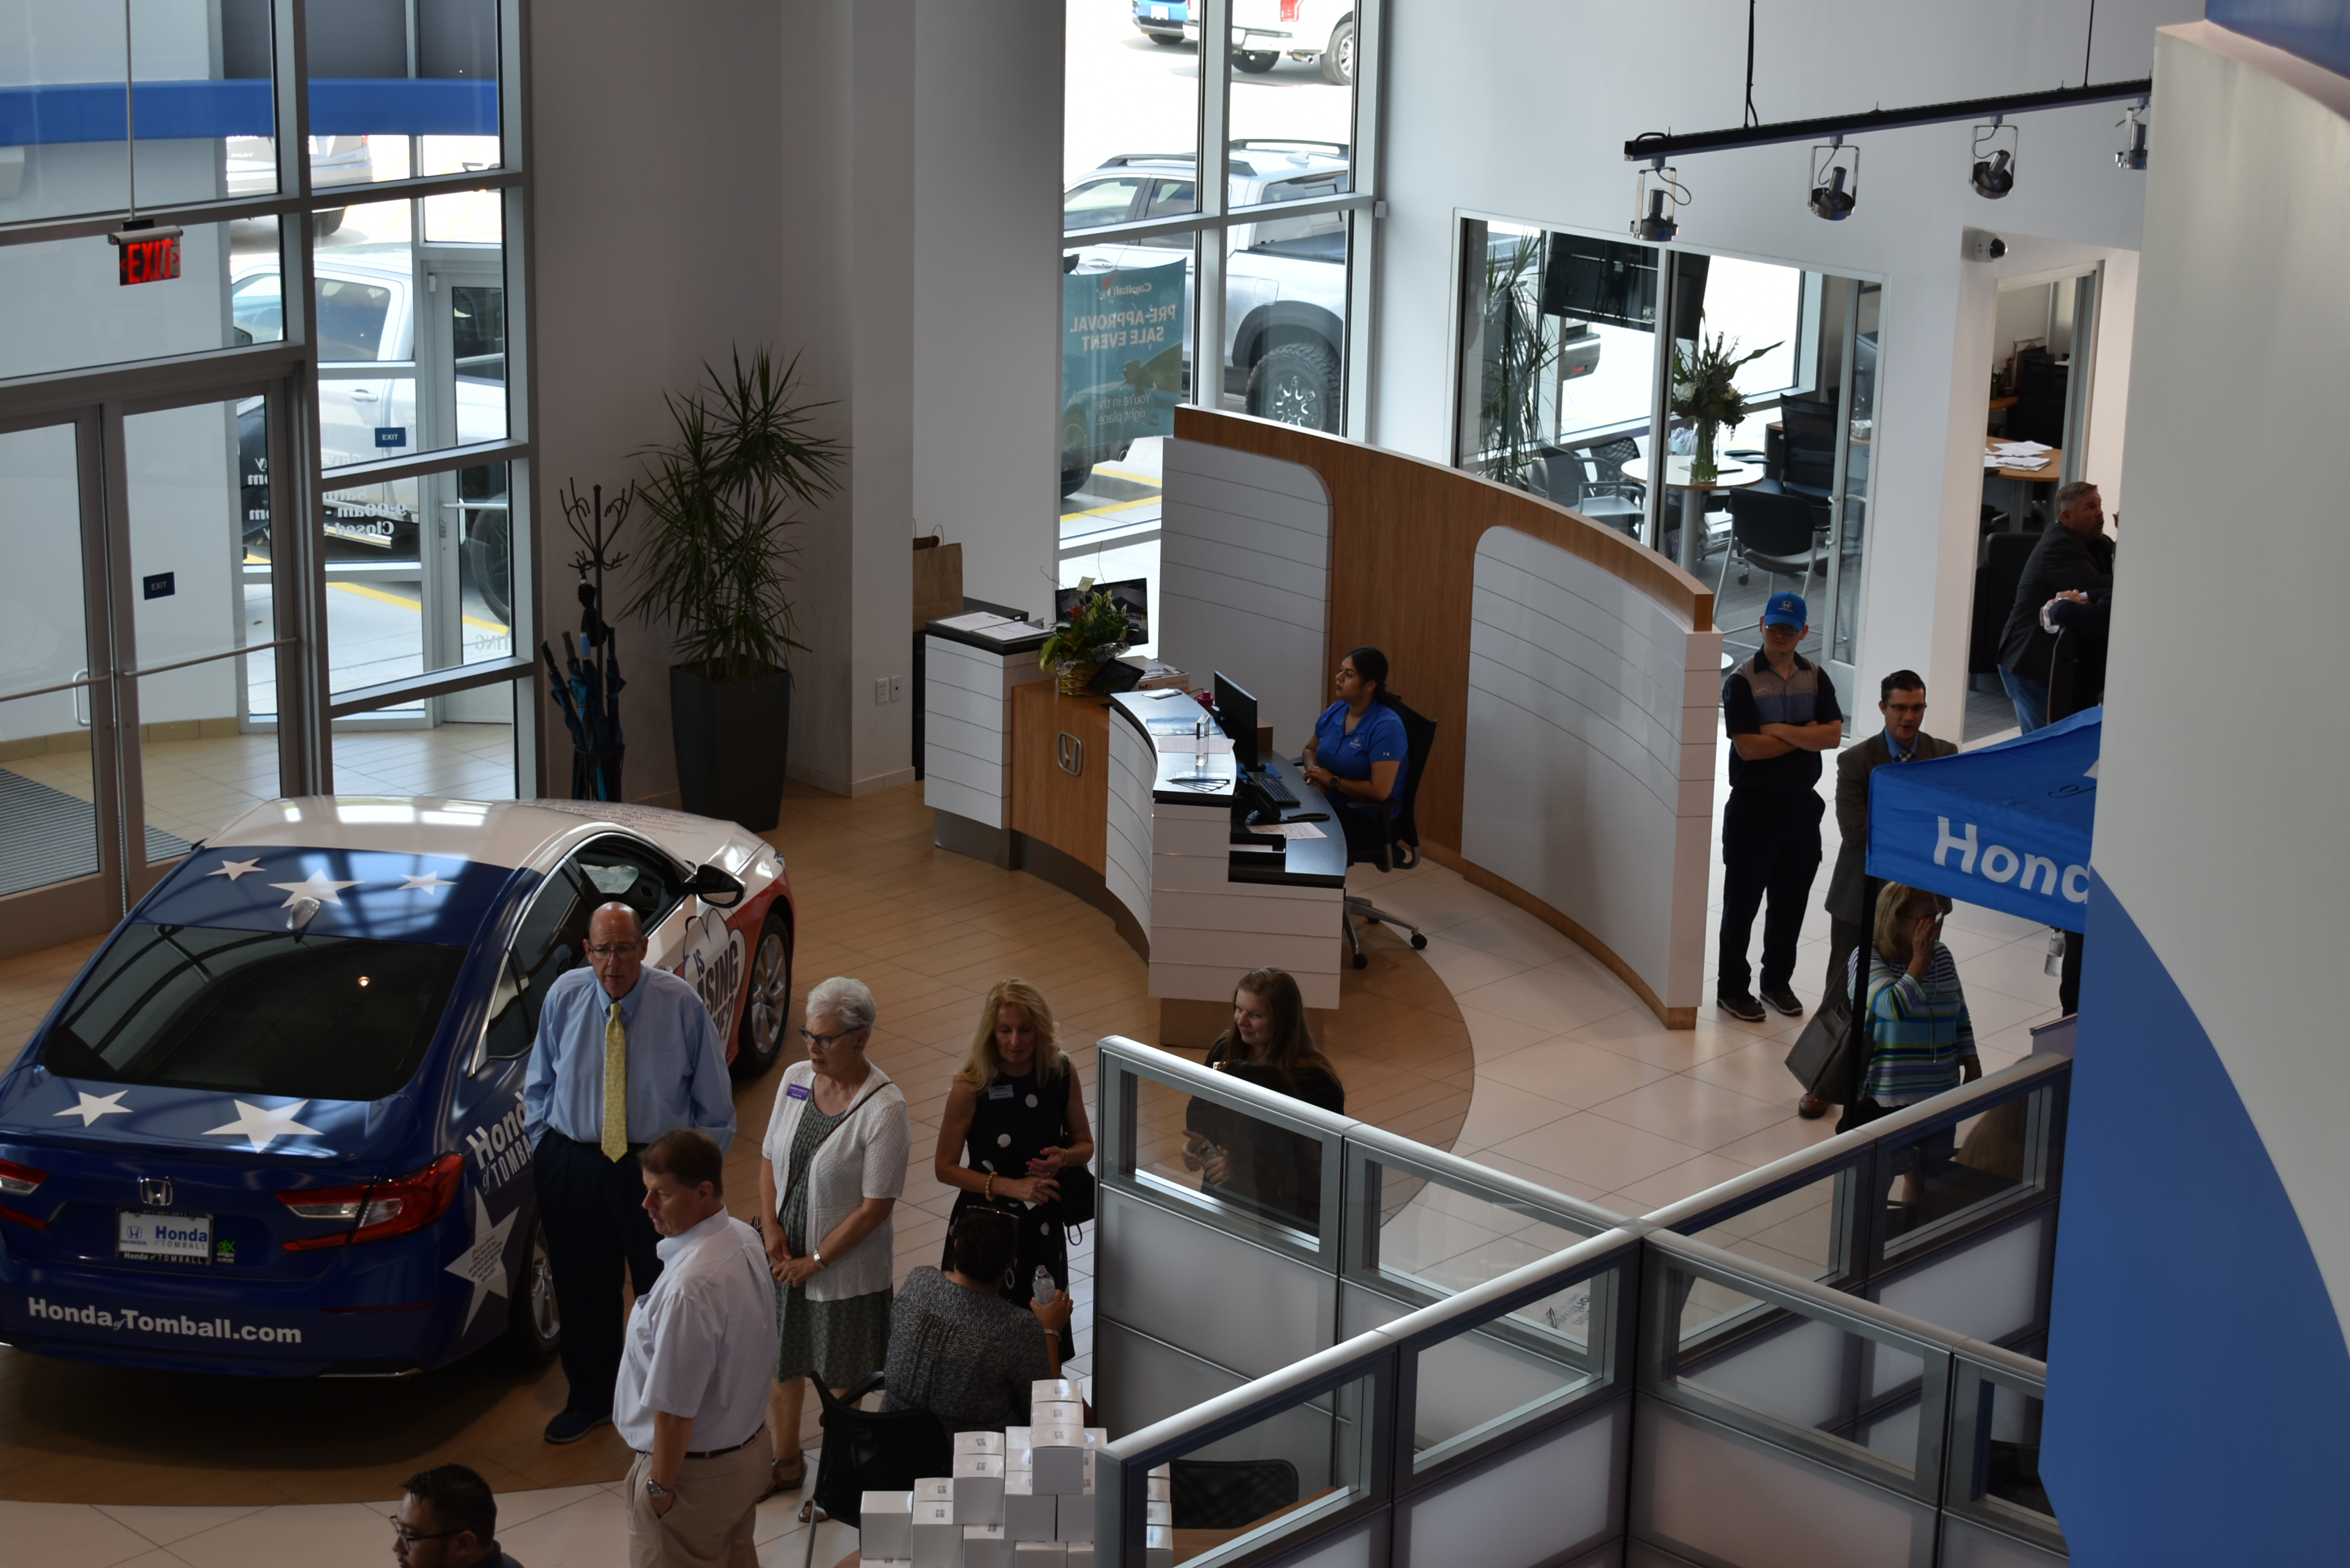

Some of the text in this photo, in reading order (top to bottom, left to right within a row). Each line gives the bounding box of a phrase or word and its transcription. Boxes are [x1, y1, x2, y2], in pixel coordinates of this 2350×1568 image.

[128, 238, 174, 283] EXIT
[151, 581, 167, 591] EXIT
[693, 949, 705, 978] IS
[156, 1226, 208, 1243] Honda
[162, 1240, 206, 1250] TOMBALL
[124, 1252, 148, 1260] Honda
[158, 1254, 202, 1264] TOMBALL
